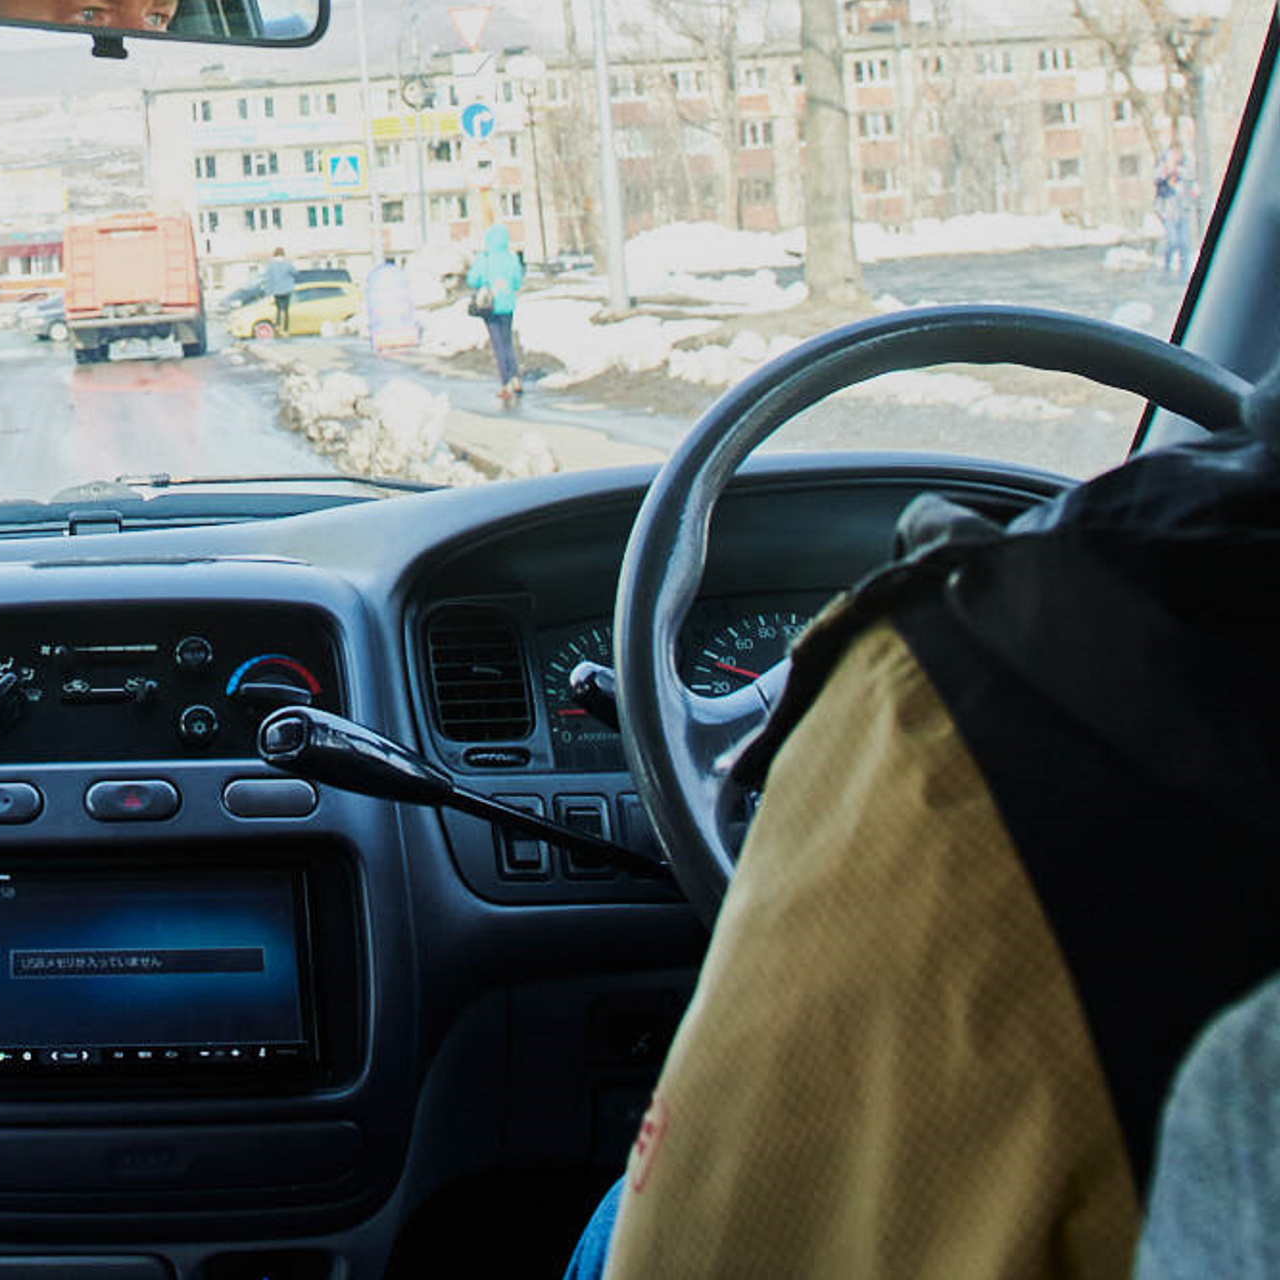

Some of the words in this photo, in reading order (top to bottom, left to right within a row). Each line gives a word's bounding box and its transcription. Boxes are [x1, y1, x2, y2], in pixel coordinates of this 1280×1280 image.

[758, 626, 776, 638] 80
[735, 639, 753, 650] 60
[712, 681, 730, 694] 20
